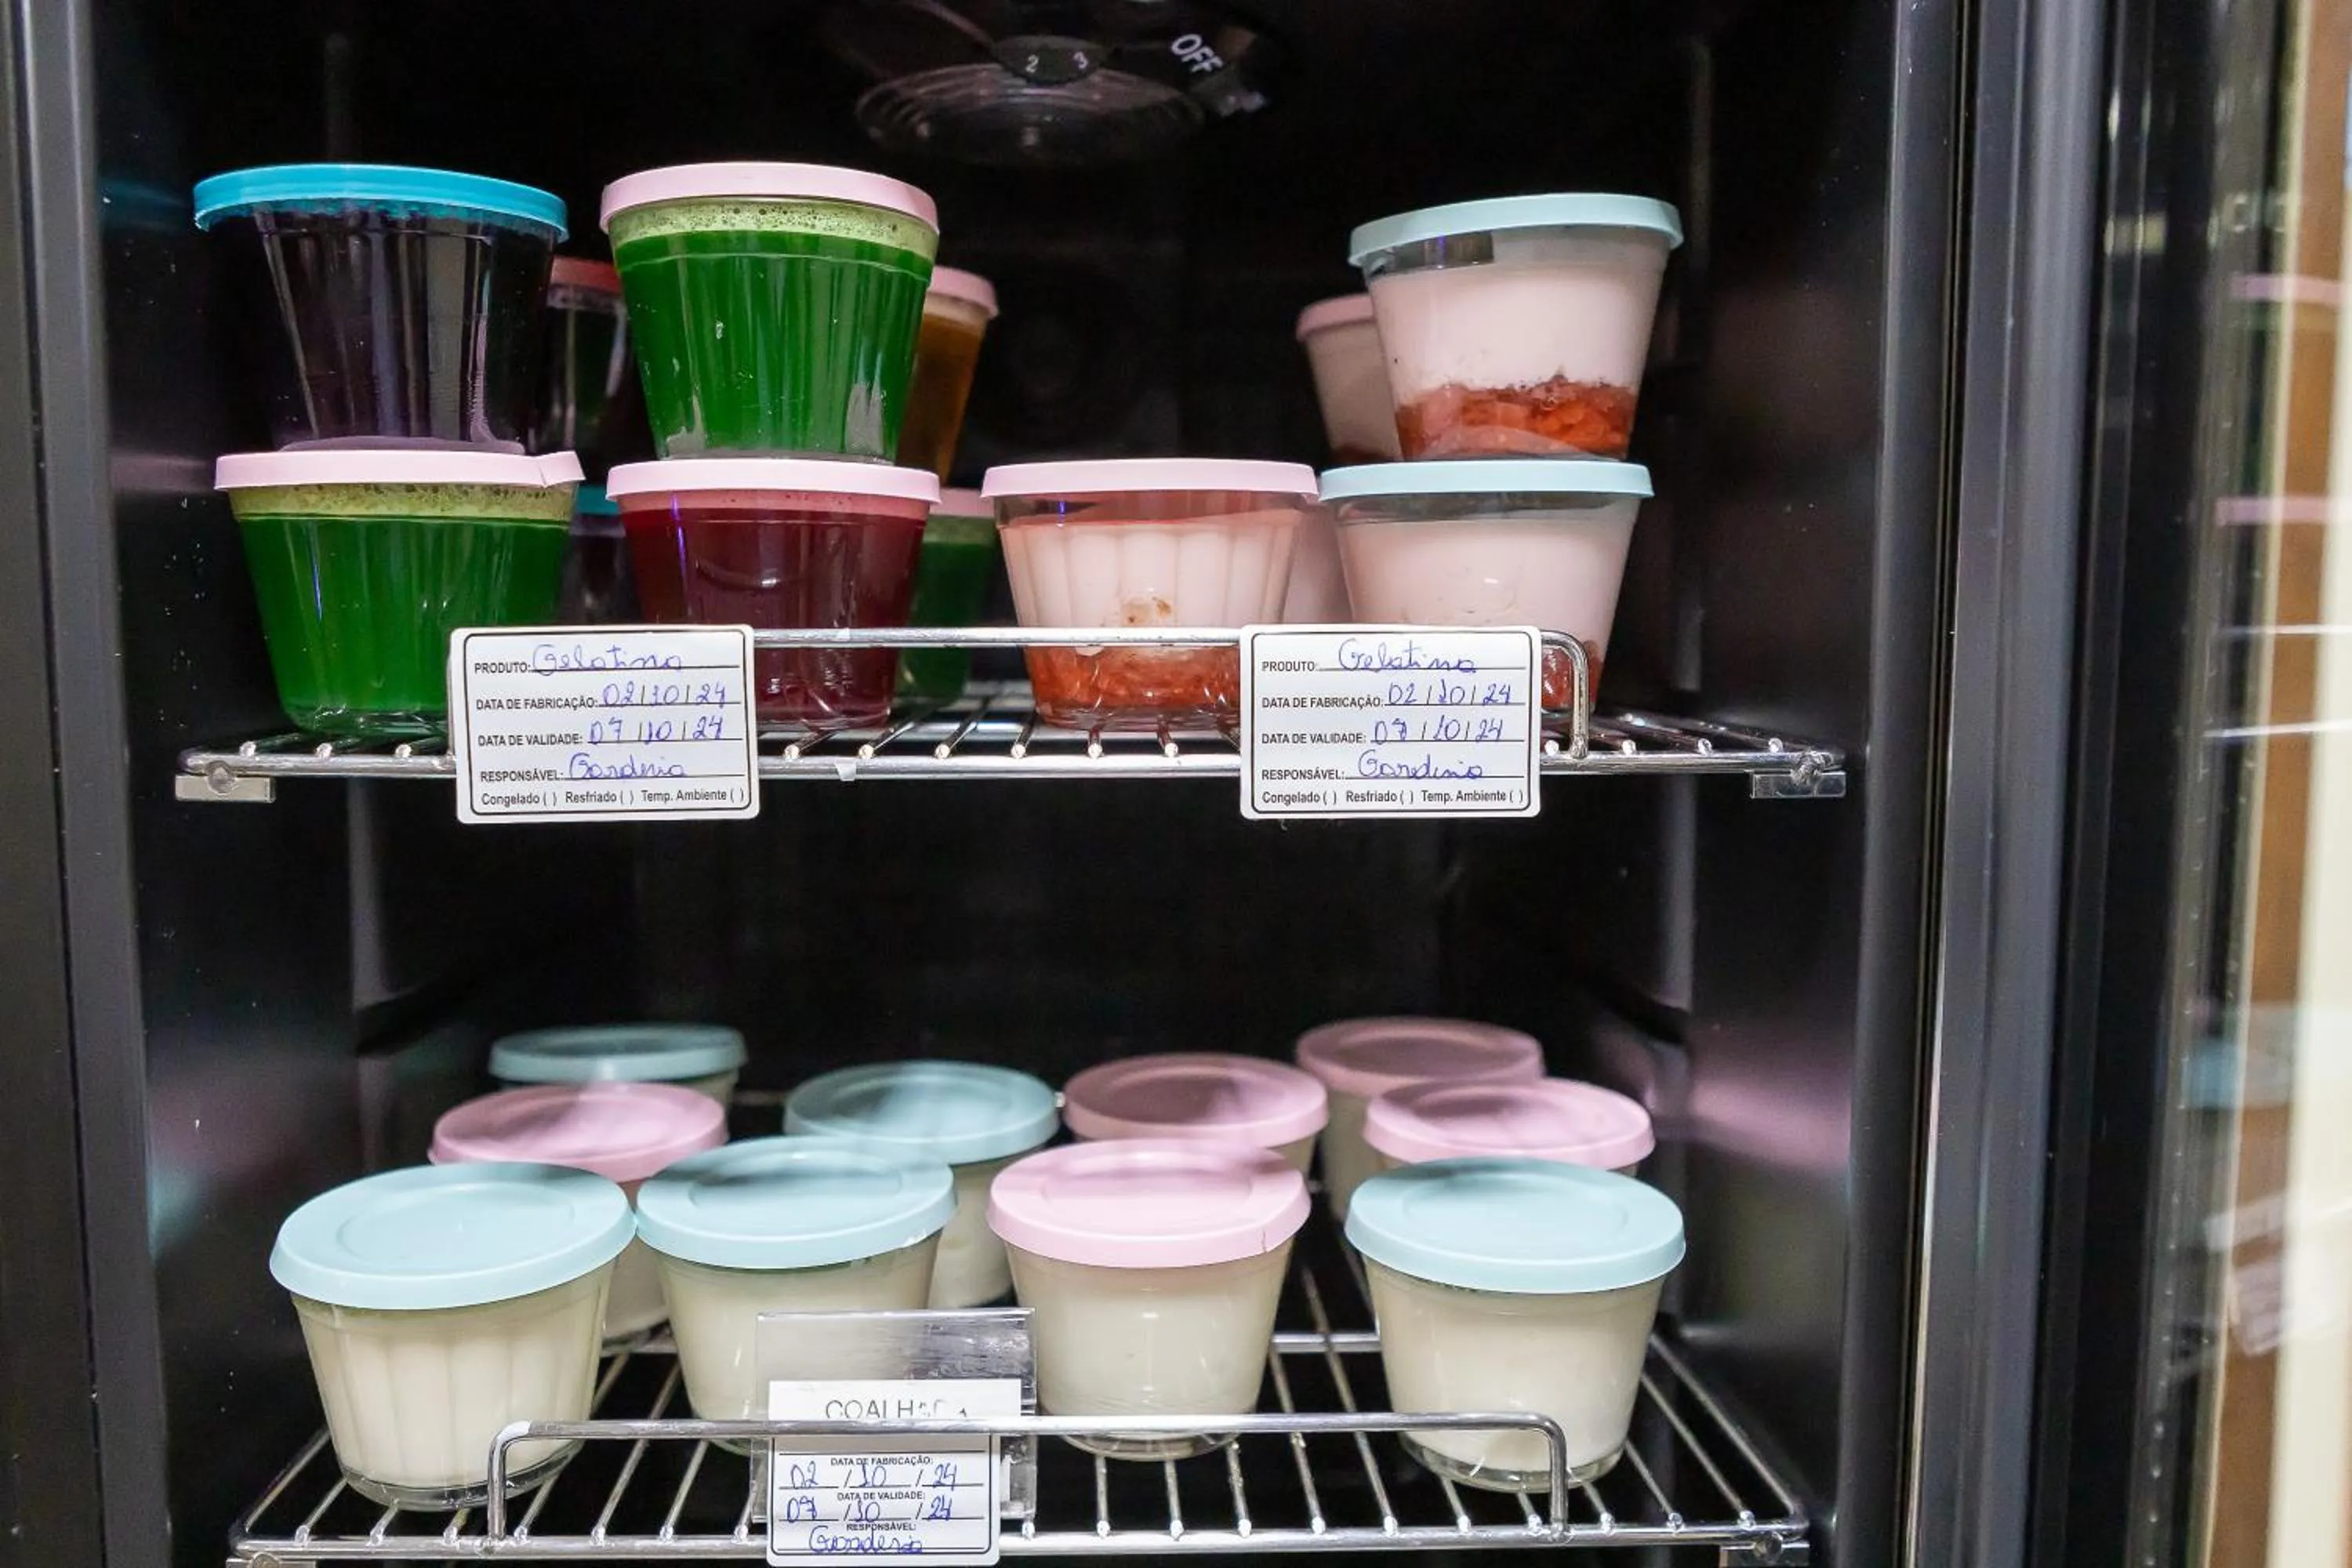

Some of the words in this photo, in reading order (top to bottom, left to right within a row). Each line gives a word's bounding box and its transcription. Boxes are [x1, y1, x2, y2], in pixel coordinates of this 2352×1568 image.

[1171, 33, 1222, 73] OFF
[1025, 55, 1039, 73] 2
[1075, 52, 1088, 69] 3
[474, 662, 530, 673] PRODUTO:
[1261, 661, 1318, 672] PRODUTO:
[477, 699, 503, 710] DATA
[505, 699, 521, 709] DE
[523, 697, 597, 711] FABRICAÇÃO:
[1261, 698, 1290, 708] DATA
[1291, 698, 1308, 707] DE
[1310, 695, 1384, 710] FABRICAÇÃO:
[478, 735, 506, 746] DATA
[509, 735, 522, 746] DE
[524, 734, 583, 745] VALIDADE:
[1261, 734, 1290, 744] DATA
[1292, 734, 1306, 744] DE
[1310, 734, 1367, 744] VALIDADE:
[481, 768, 564, 782] RESPONSÁVEL:
[1261, 767, 1345, 780] RESPONSÁVEL:
[481, 793, 540, 808] Congelado
[566, 791, 616, 803] Resfriado
[642, 789, 673, 803] Temp.
[677, 789, 727, 800] Ambiente
[1262, 791, 1320, 806] Congelado
[1346, 791, 1397, 803] Resfriado
[1422, 791, 1454, 804] Temp.
[1456, 790, 1506, 802] Ambiente
[826, 1399, 967, 1418] COALH
[871, 1455, 932, 1465] FABRICAÇÃO:
[847, 1523, 916, 1531] RESPONSÁVEL:
